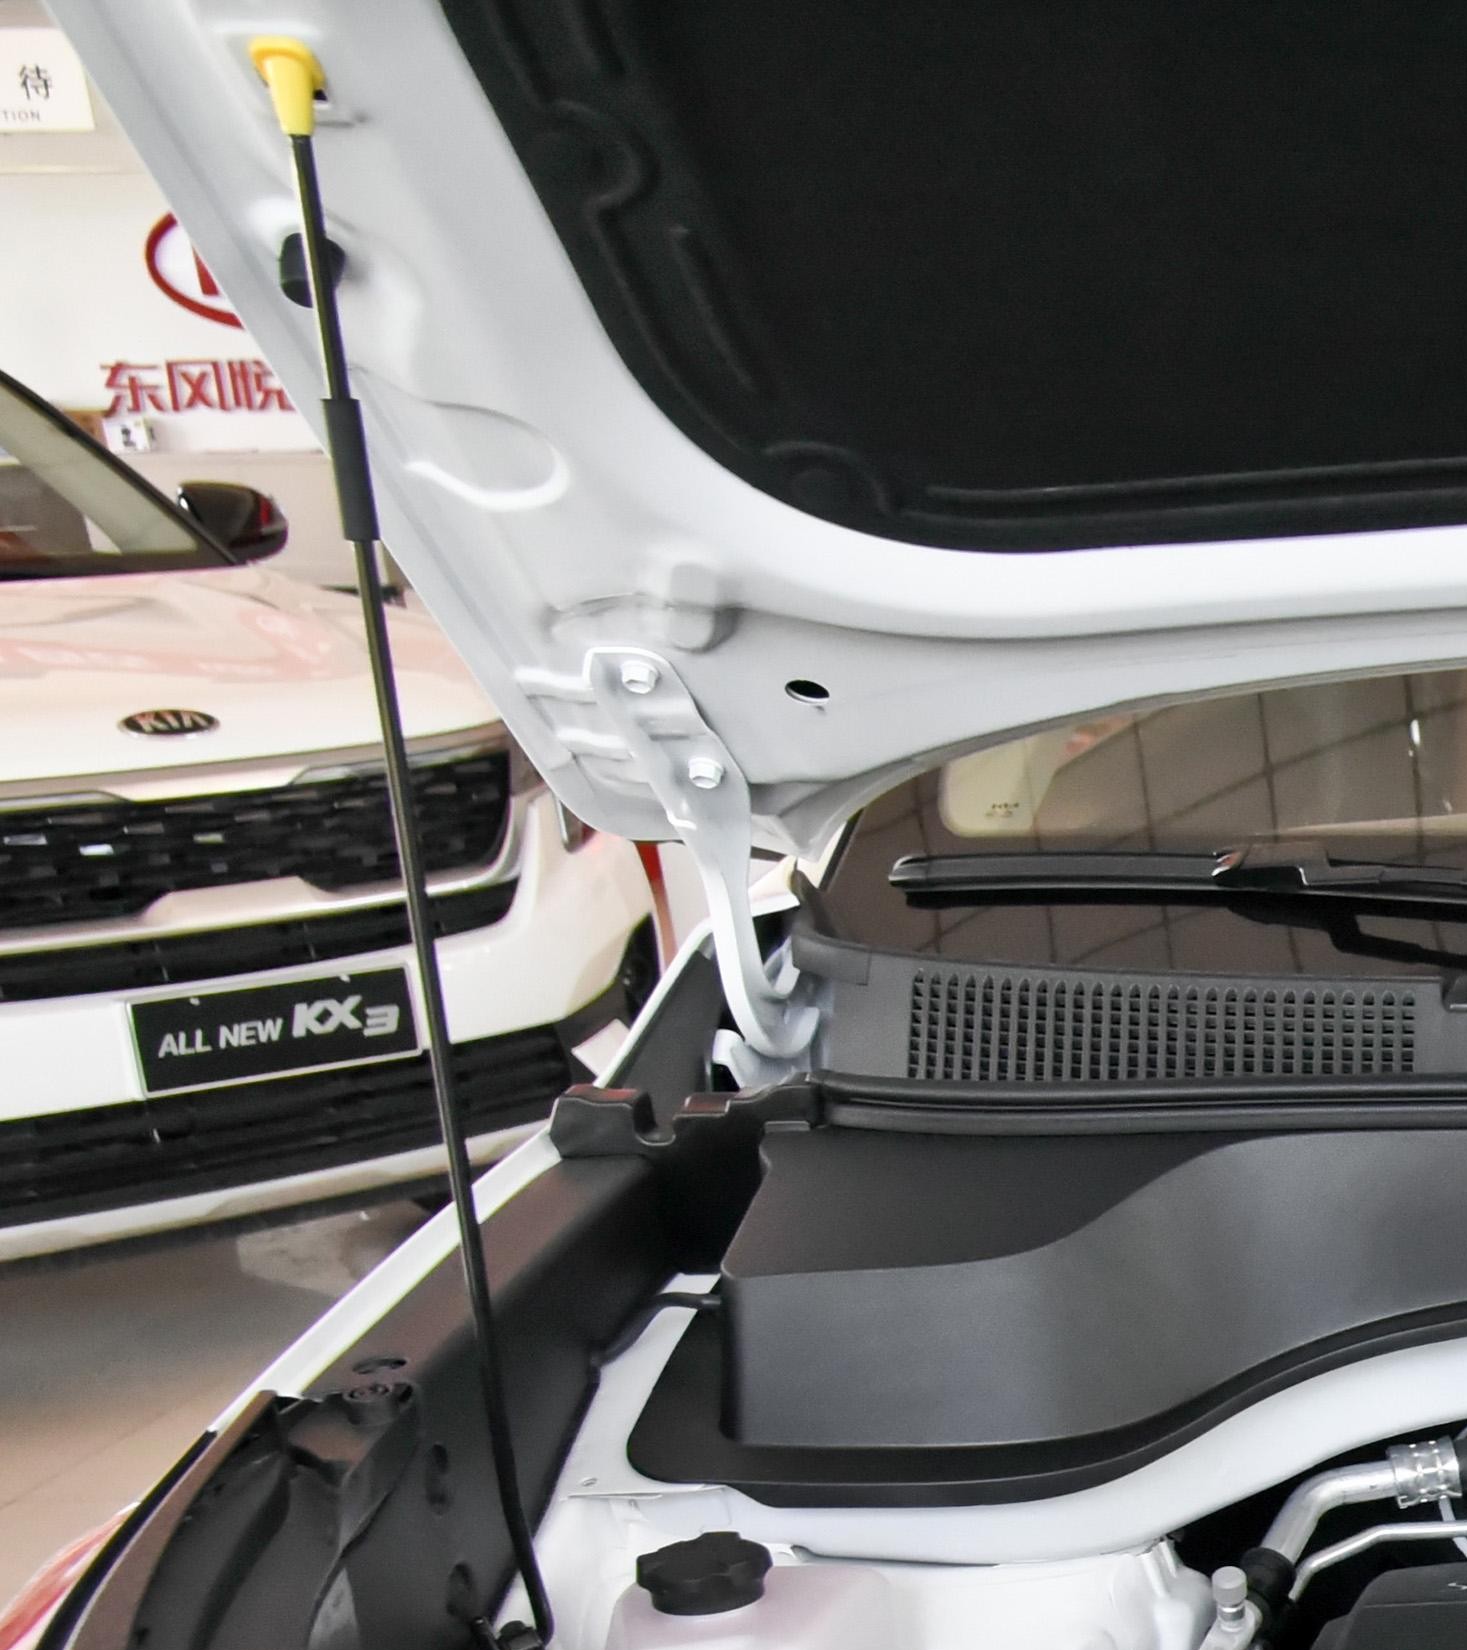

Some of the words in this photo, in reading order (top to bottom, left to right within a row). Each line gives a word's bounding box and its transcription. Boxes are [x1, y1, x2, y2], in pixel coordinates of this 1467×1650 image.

[19, 65, 52, 100] 待
[158, 1028, 212, 1058] ALL
[219, 1017, 284, 1049] NEW
[291, 995, 400, 1038] KX3
